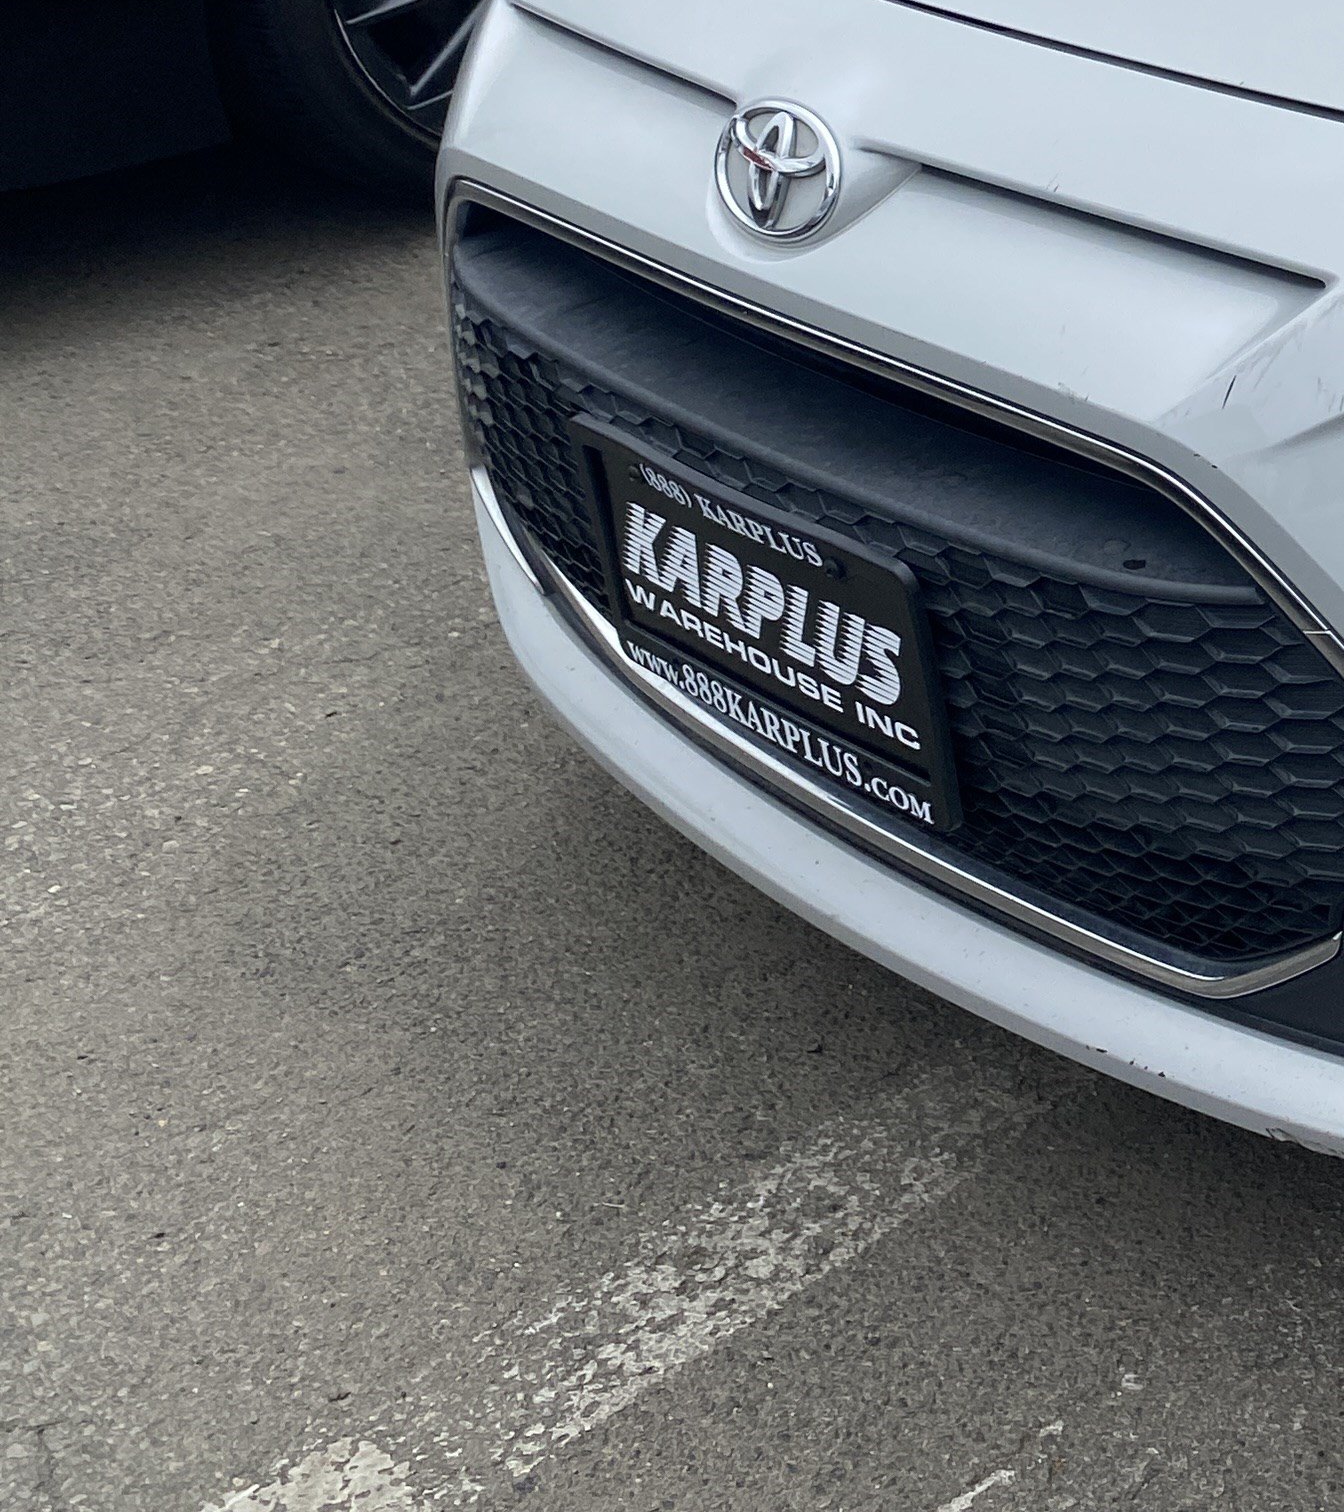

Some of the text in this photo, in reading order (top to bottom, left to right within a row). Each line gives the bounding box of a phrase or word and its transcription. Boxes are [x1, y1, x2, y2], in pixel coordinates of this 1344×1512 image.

[639, 463, 824, 568] (888) KARPLUS
[622, 500, 902, 707] KARPLUS
[625, 578, 921, 751] WAREHOUSE INC
